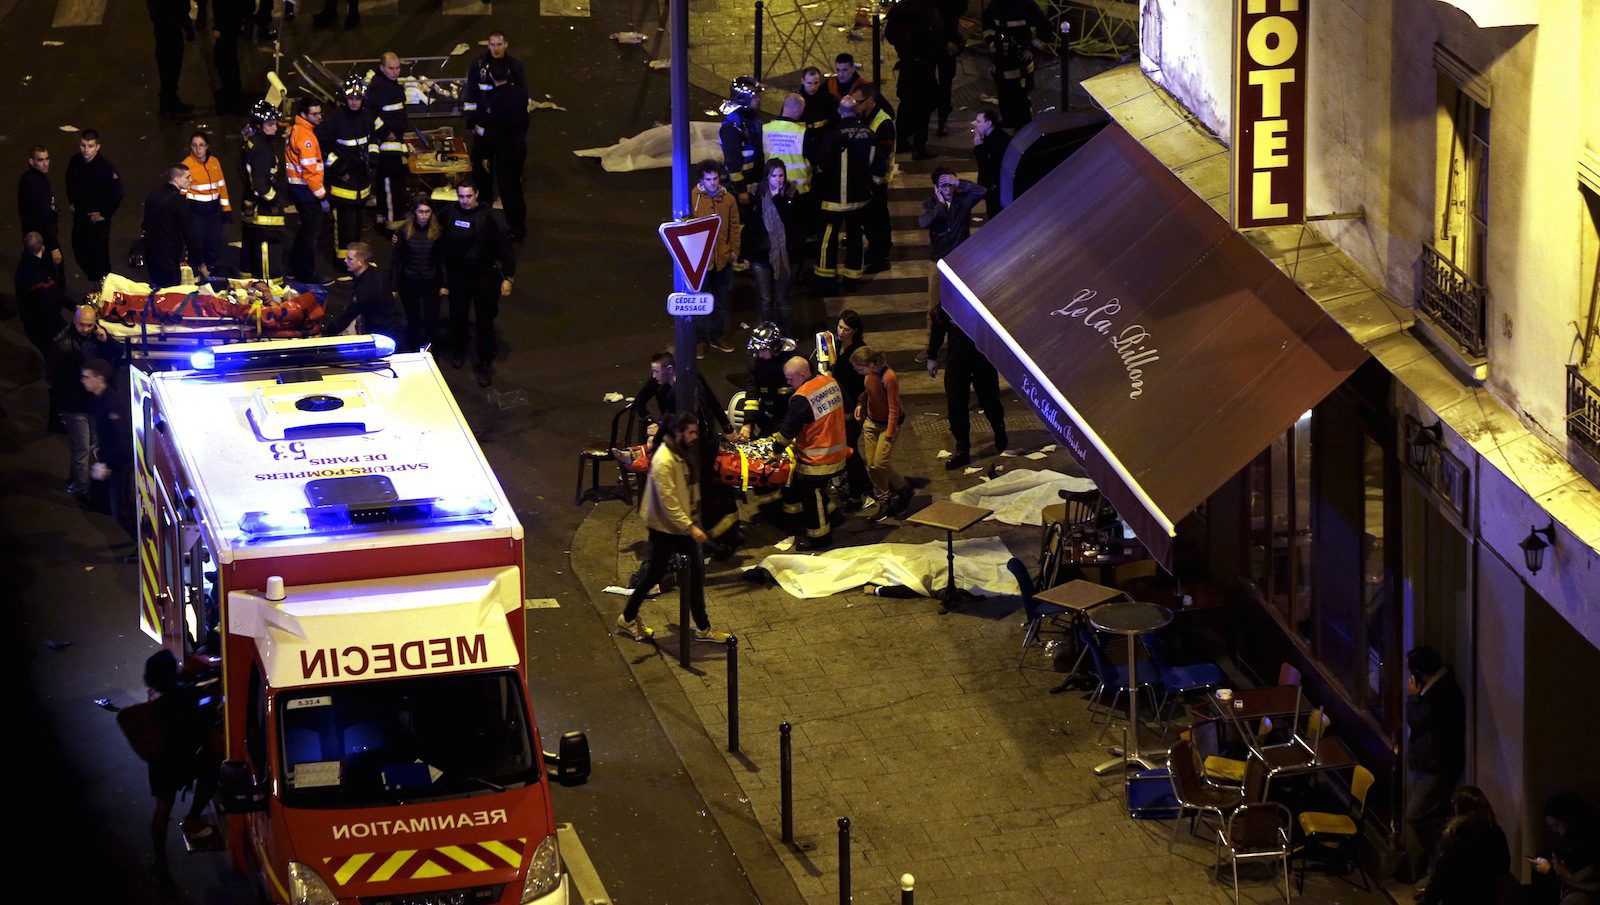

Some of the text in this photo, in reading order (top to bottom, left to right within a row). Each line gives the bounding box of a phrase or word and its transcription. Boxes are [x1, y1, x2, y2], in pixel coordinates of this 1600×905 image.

[1246, 0, 1299, 219] OTEL
[675, 296, 696, 304] CÉDEZ
[1050, 288, 1098, 318] Le
[810, 386, 840, 405] POMPIERS
[817, 396, 841, 413] DE PARIS
[309, 453, 389, 466] DE PARIS
[254, 462, 430, 482] SAPEURS-POMPIERS
